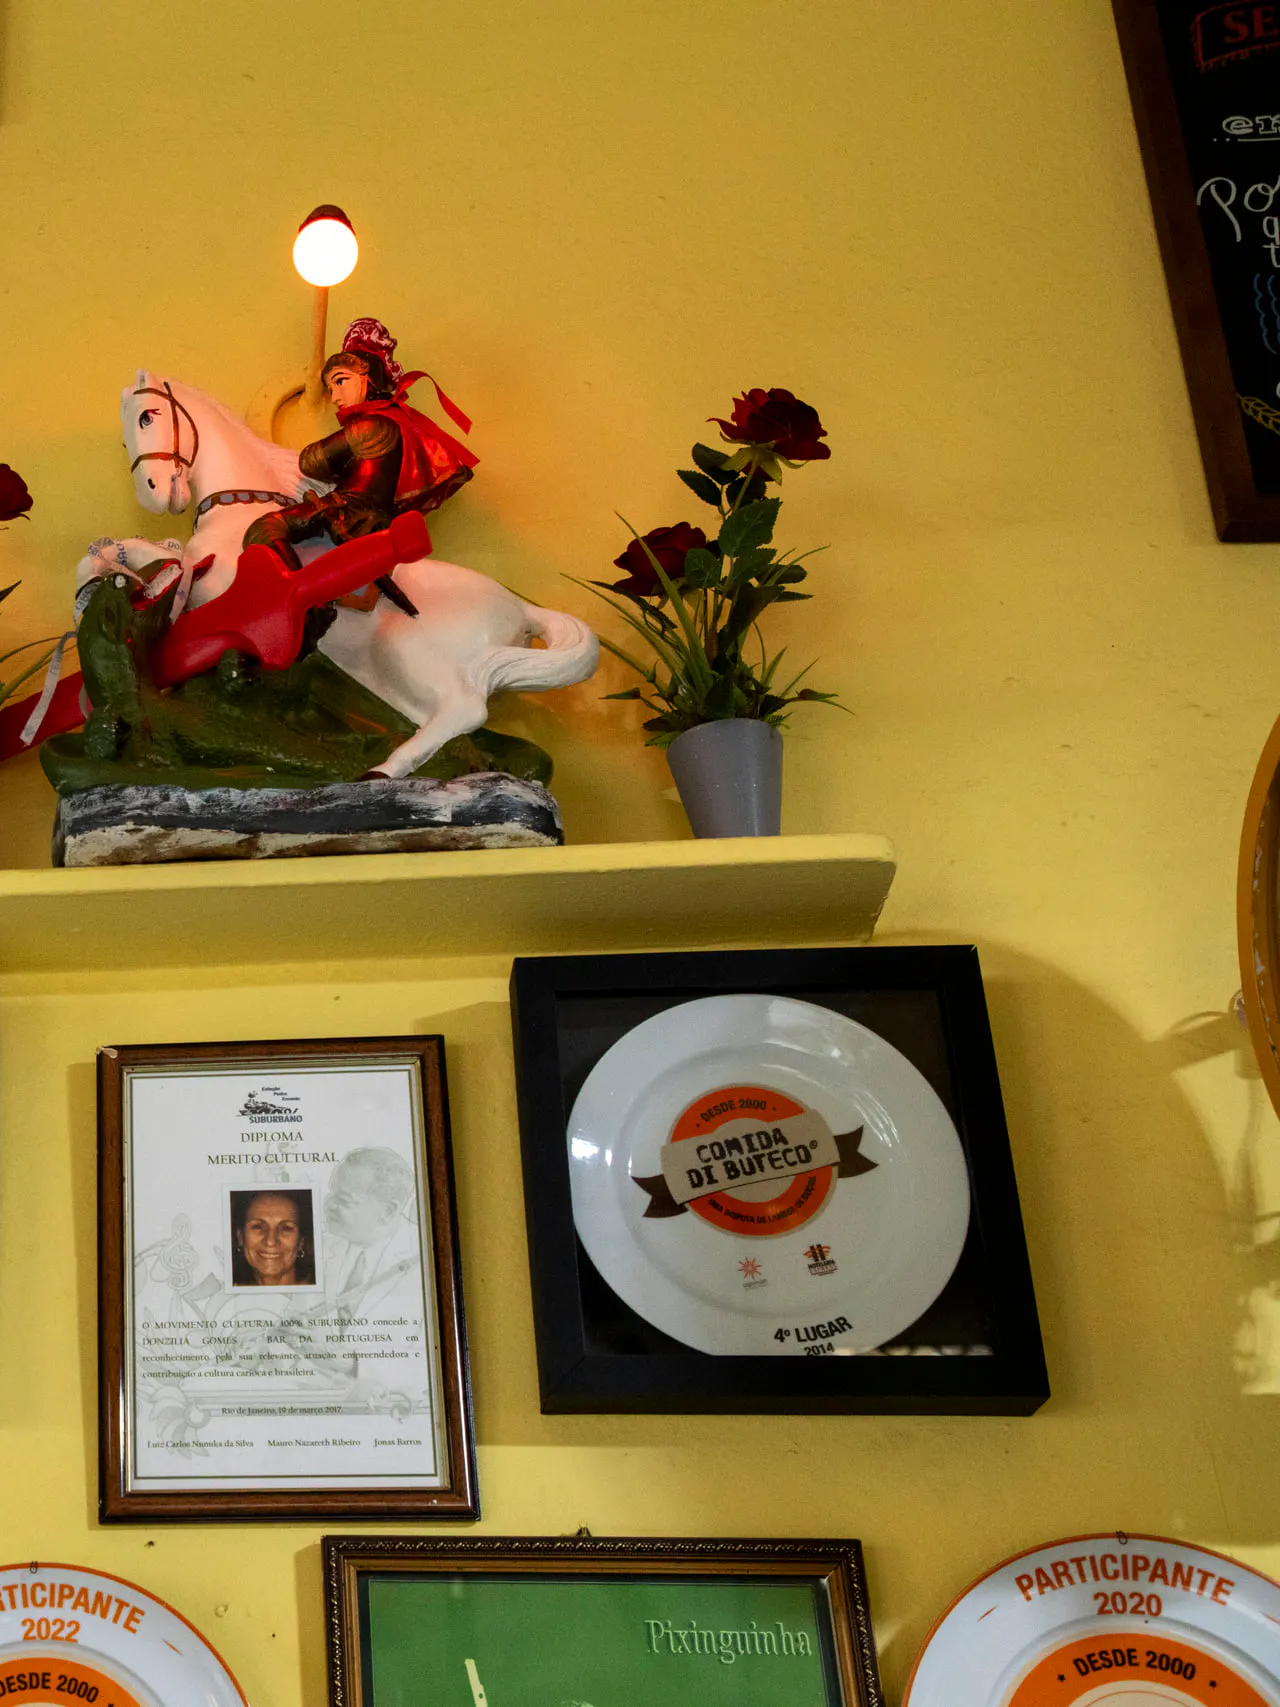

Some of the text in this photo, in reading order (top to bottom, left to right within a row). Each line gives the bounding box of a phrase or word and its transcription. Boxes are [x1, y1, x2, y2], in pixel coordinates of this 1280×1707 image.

[249, 1115, 303, 1124] SUBURBANO
[699, 1097, 767, 1124] DESDE 2000
[240, 1131, 304, 1143] DIPLOMA
[695, 1127, 790, 1164] COMIDA
[207, 1151, 339, 1165] MERITO CULTURAL
[686, 1166, 718, 1190] DI
[142, 1321, 150, 1329] O
[154, 1320, 218, 1329] MOVIMENTO
[222, 1320, 274, 1329] CULTURAL
[280, 1319, 303, 1328] 100%
[307, 1318, 369, 1328] SUBURBANO
[372, 1316, 409, 1326] concede
[795, 1316, 853, 1343] LUGAR
[202, 1336, 238, 1345] GOMES
[267, 1335, 287, 1344] BAR
[299, 1335, 313, 1343] DA
[325, 1334, 393, 1343] PORTUGUESA
[804, 1342, 835, 1356] 2014
[142, 1353, 210, 1362] reconhecimento
[304, 1352, 337, 1362] atuação
[342, 1350, 409, 1362] empreendedora
[142, 1369, 196, 1379] contribuição
[203, 1369, 234, 1378] cultura
[234, 1369, 266, 1377] carioca
[221, 1406, 234, 1415] Rio
[235, 1406, 246, 1415] de
[246, 1405, 277, 1417] Janeiro,
[278, 1406, 286, 1414] 19
[287, 1405, 298, 1414] de
[299, 1406, 323, 1416] março
[147, 1440, 164, 1449] Luiz
[165, 1440, 191, 1449] Carlos
[223, 1439, 233, 1448] da
[234, 1439, 254, 1448] Silva
[267, 1439, 293, 1447] Mauro
[294, 1438, 330, 1447] Nazareth
[331, 1438, 361, 1447] Ribeiro
[373, 1438, 395, 1448] Jonas
[396, 1437, 422, 1446] Barros
[1014, 1553, 1236, 1606] PARTICIPANTE
[1093, 1591, 1163, 1617] 2020
[21, 1617, 81, 1643] 2022
[644, 1619, 813, 1664] Pixinguinha
[1072, 1648, 1197, 1682] DESDE 2000
[57, 1673, 100, 1704] 2000
